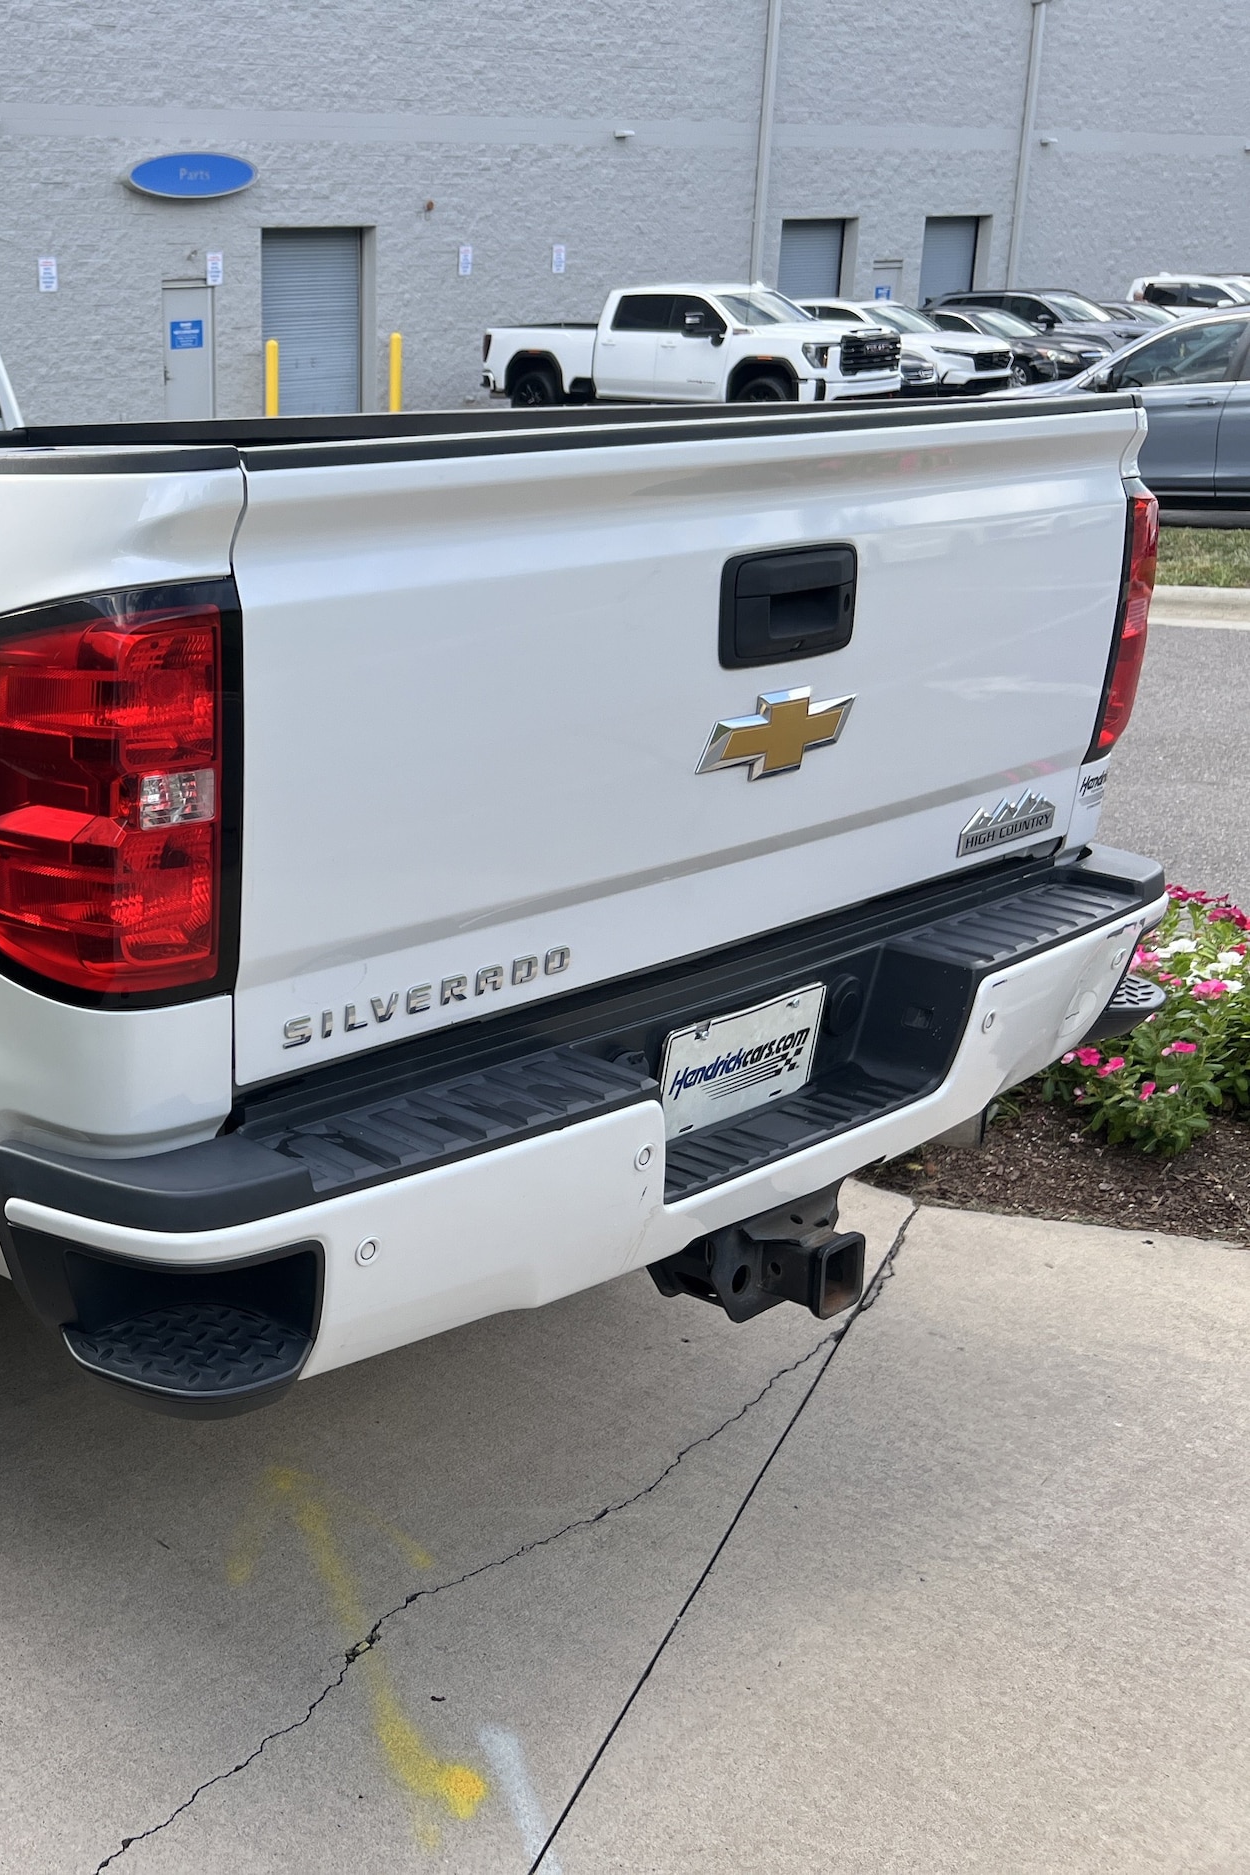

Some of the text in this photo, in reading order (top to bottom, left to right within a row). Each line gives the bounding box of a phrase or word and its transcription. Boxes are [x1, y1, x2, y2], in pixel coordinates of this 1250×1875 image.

[179, 167, 211, 181] Parts
[965, 813, 1051, 849] HIGH COUNTRY
[282, 945, 571, 1049] SILVERADO
[668, 1027, 811, 1101] Hendrickcars.com
